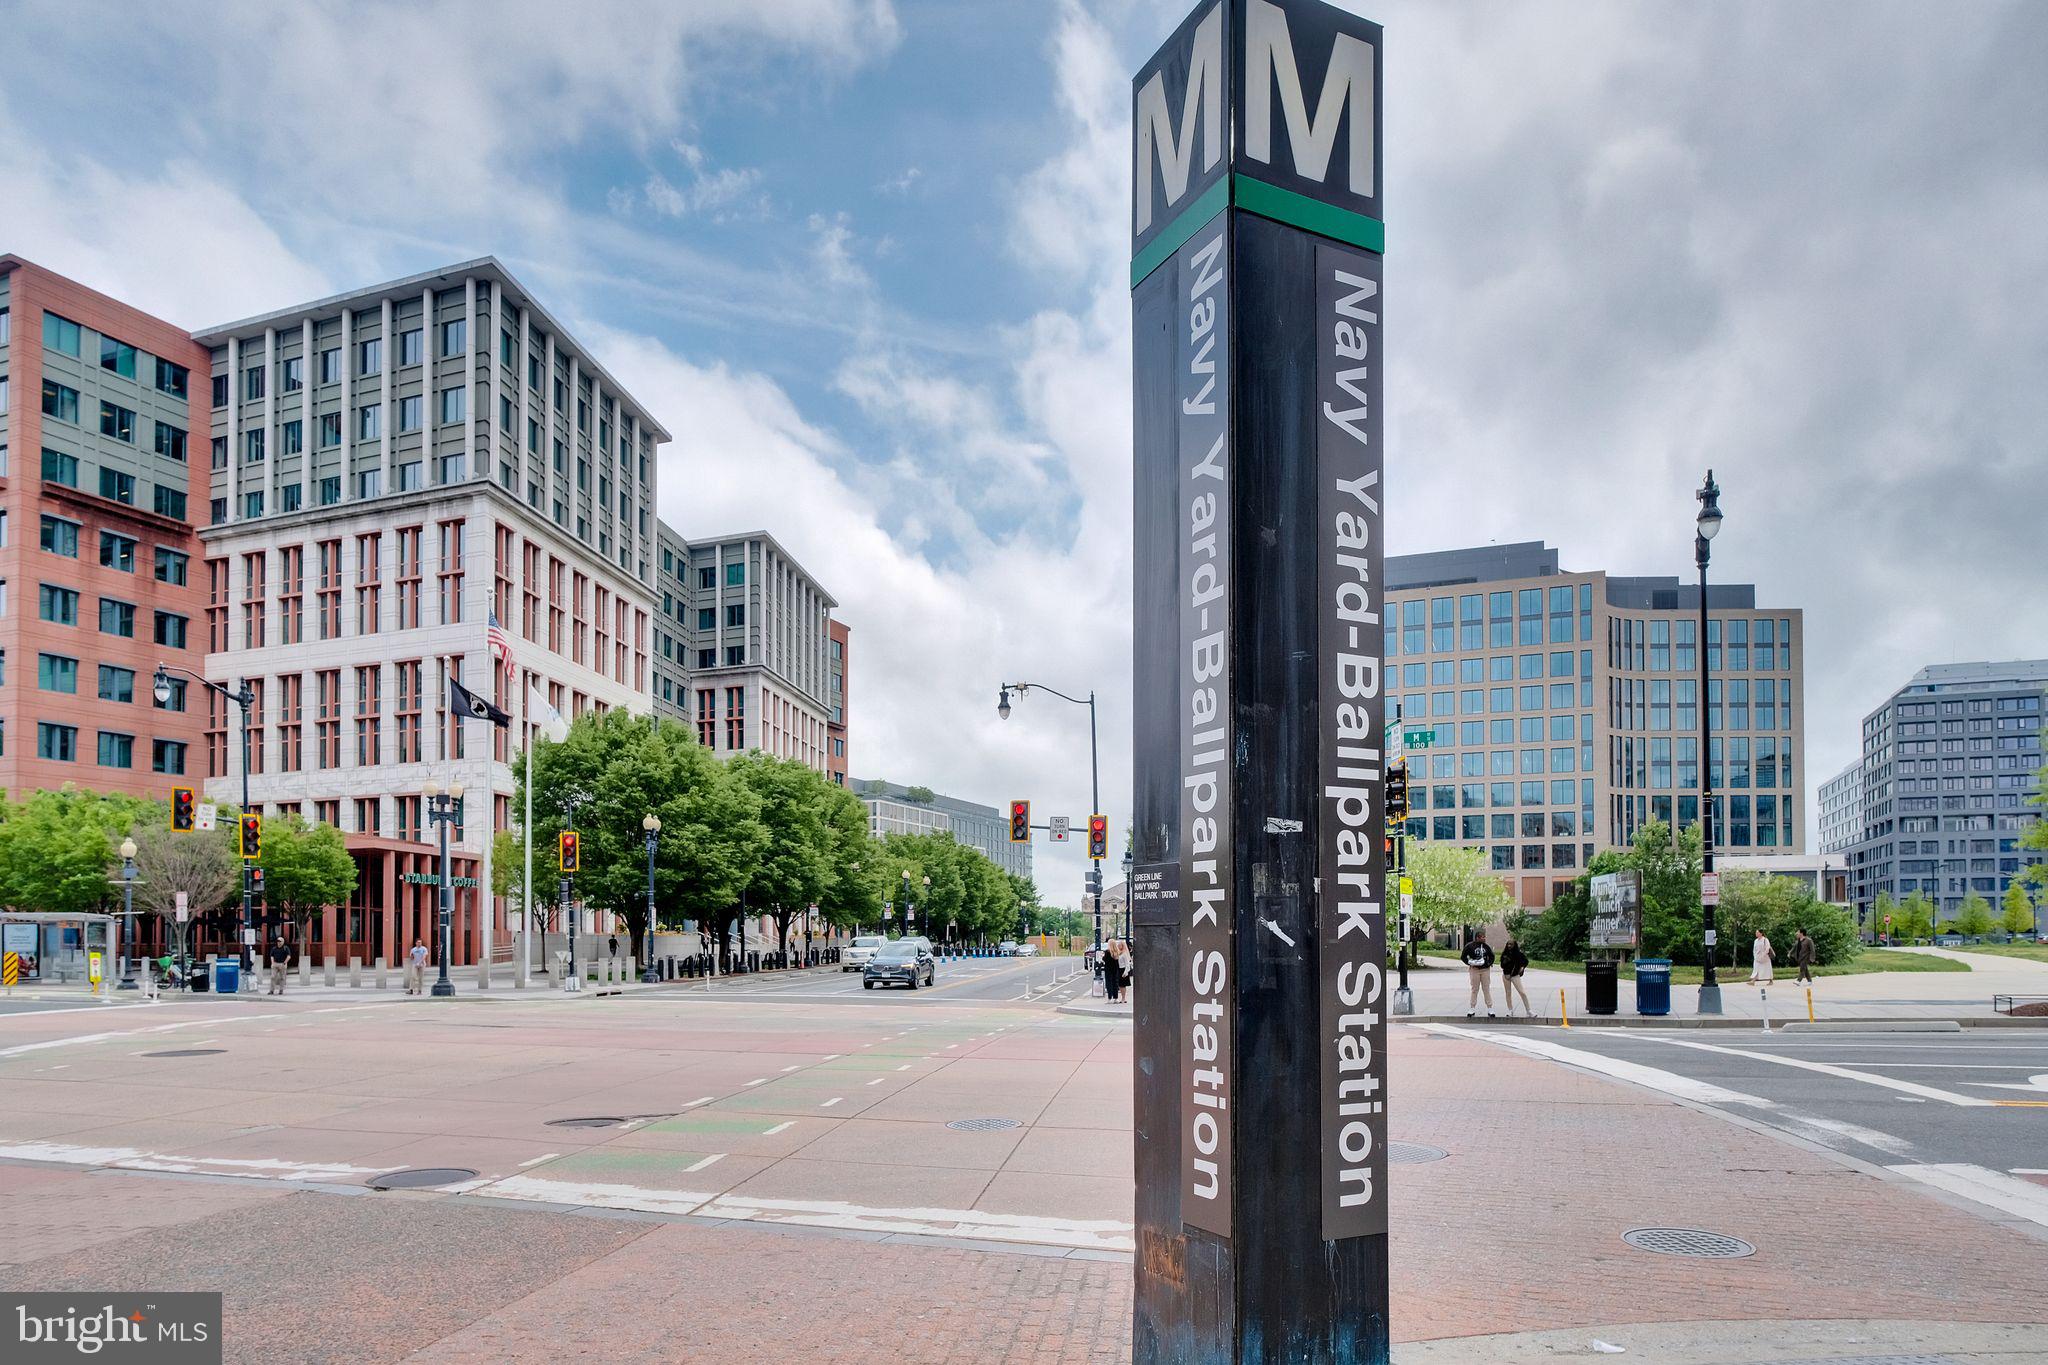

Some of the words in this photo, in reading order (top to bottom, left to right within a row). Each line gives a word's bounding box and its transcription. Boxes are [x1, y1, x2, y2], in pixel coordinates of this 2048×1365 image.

[1137, 0, 1221, 236] M
[1245, 0, 1373, 198] M
[1183, 234, 1222, 415] Navy
[1323, 270, 1377, 445] Navy
[1185, 432, 1225, 927] Yard-Ballpark
[1325, 470, 1379, 939] Yard-Ballpark
[1413, 733, 1420, 742] M
[405, 873, 441, 885] STARBU
[1134, 873, 1150, 881] GREEN
[1151, 872, 1162, 880] LINE
[1134, 882, 1146, 890] NAVY
[1147, 882, 1159, 890] YARD
[1134, 891, 1158, 900] BALLPARK
[1192, 950, 1226, 1200] Station
[1338, 961, 1382, 1207] Station
